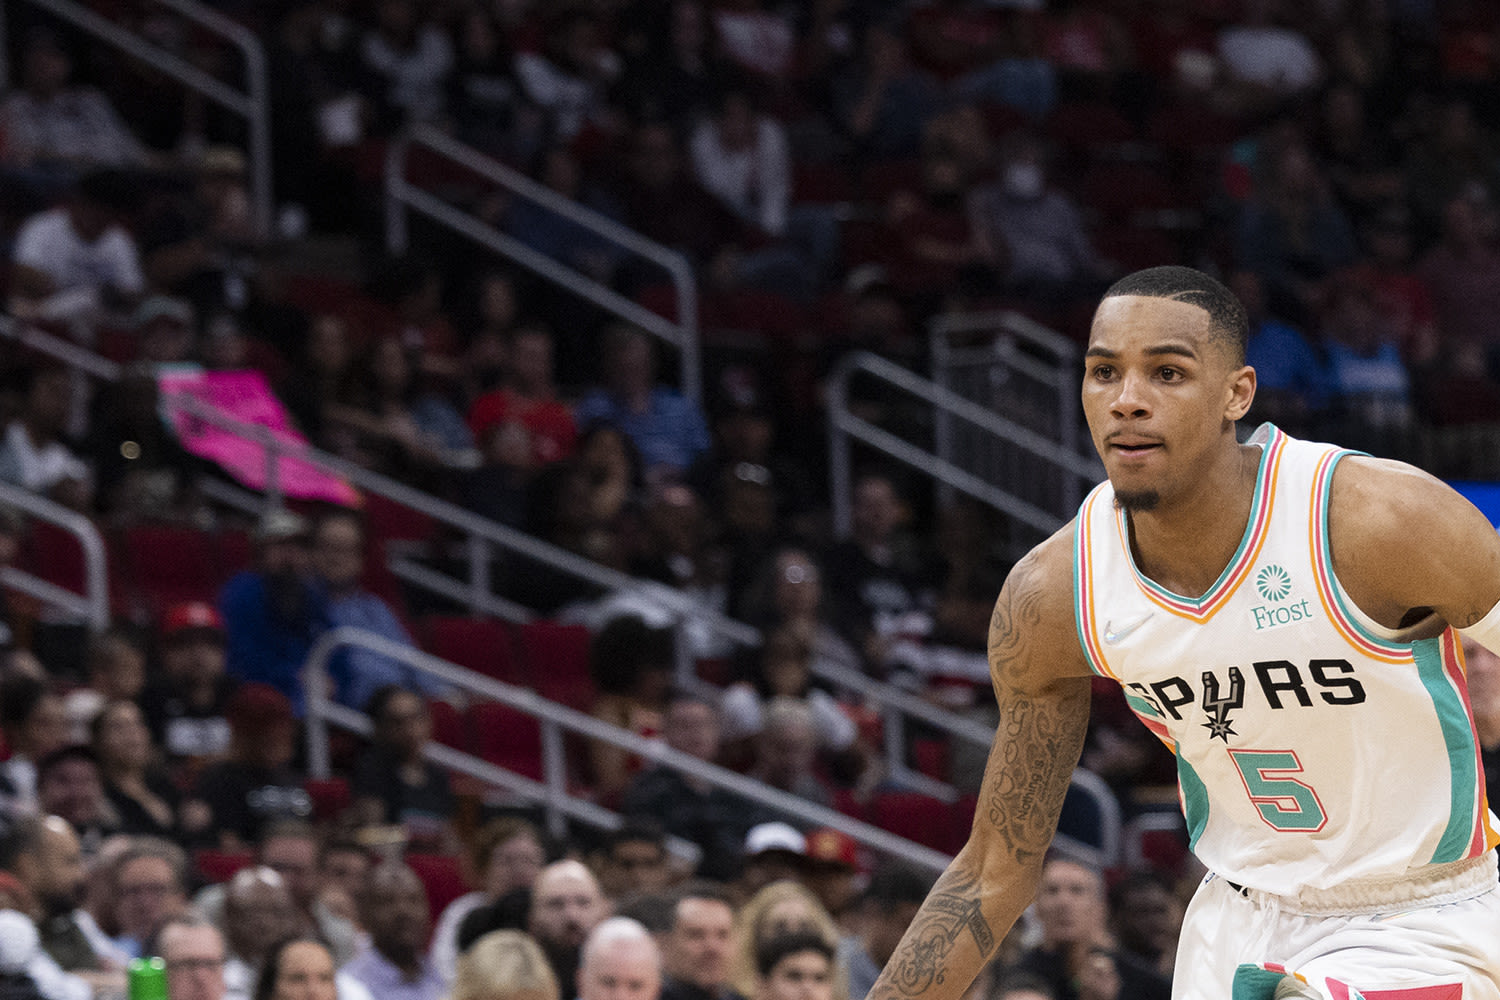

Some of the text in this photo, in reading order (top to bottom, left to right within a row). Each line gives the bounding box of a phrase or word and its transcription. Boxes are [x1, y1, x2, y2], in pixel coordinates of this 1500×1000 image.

[1250, 598, 1313, 631] Frost
[1127, 659, 1367, 745] SPURS
[1015, 774, 1043, 821] Nothing
[1227, 748, 1329, 833] 5
